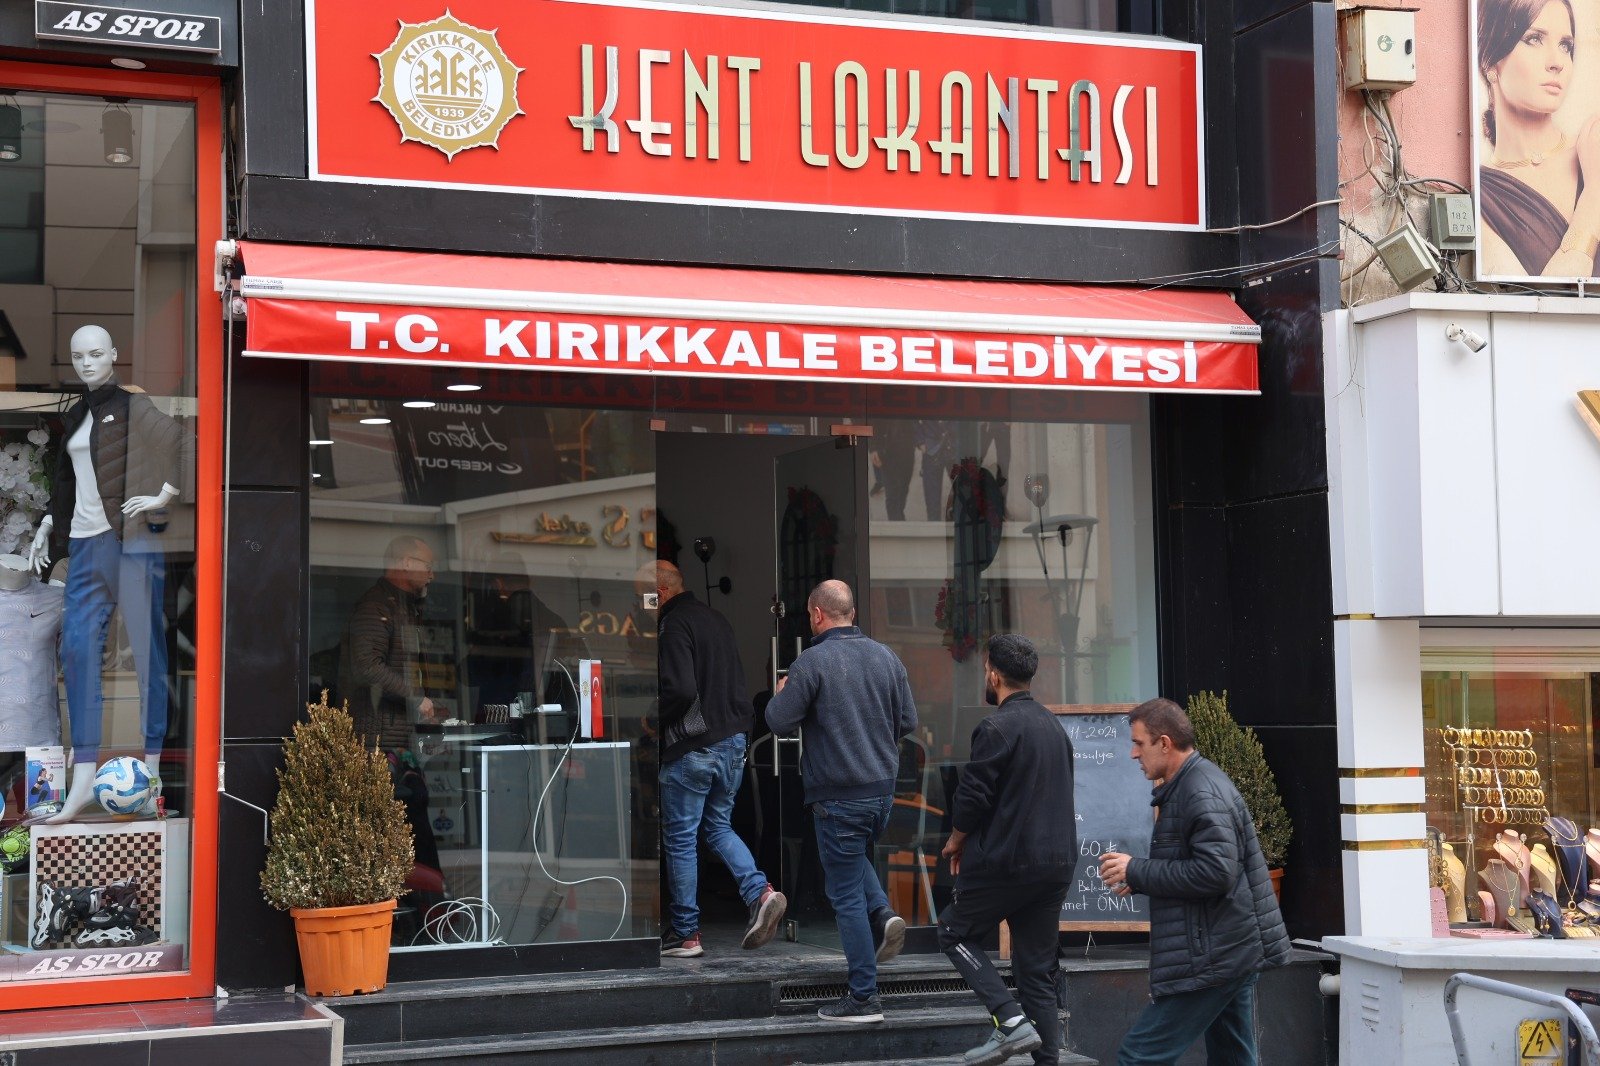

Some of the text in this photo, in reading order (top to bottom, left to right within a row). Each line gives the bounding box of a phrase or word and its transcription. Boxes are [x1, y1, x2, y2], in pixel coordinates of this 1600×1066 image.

[53, 10, 205, 42] AS SPOR
[401, 33, 496, 74] KIRIKKALE
[402, 99, 496, 138] BELEDİYESİ
[434, 106, 465, 119] 1939
[567, 43, 1159, 186] KENT LOKANTASI
[336, 310, 1198, 383] T.C. KIRIKKALE BELEDİYESİ
[1080, 837, 1101, 857] 60
[25, 951, 164, 975] AS SPOR
